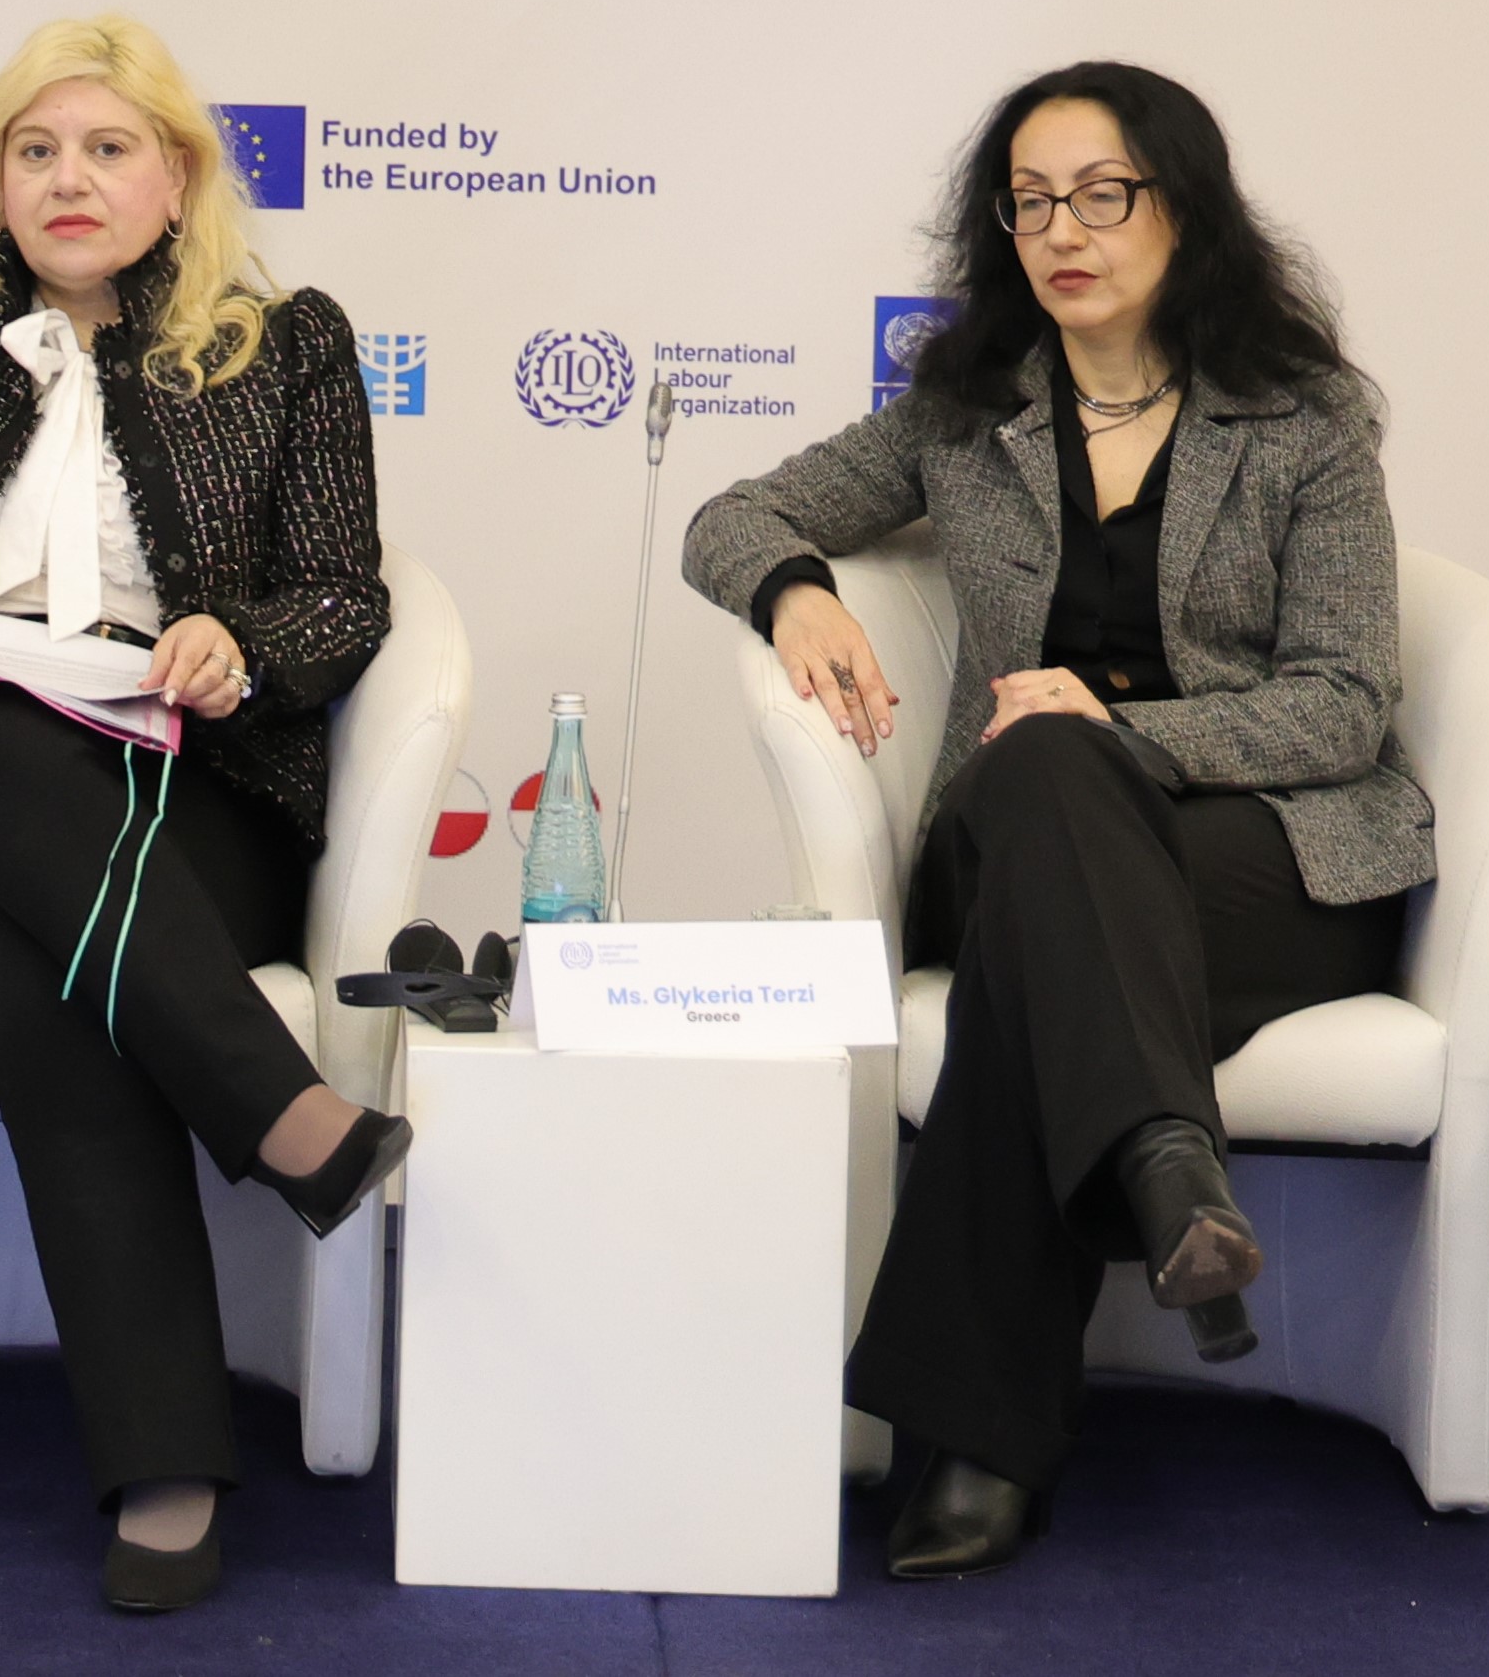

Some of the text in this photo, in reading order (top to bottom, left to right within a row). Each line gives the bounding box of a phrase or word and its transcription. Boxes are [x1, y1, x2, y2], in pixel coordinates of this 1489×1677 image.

[323, 121, 497, 156] Funded by
[322, 163, 655, 197] the European Union
[655, 342, 794, 364] International
[551, 350, 601, 395] ILO
[671, 395, 795, 418] rganization
[608, 984, 814, 1010] Ms. Glykeria Terzi
[687, 1011, 740, 1022] Greece
